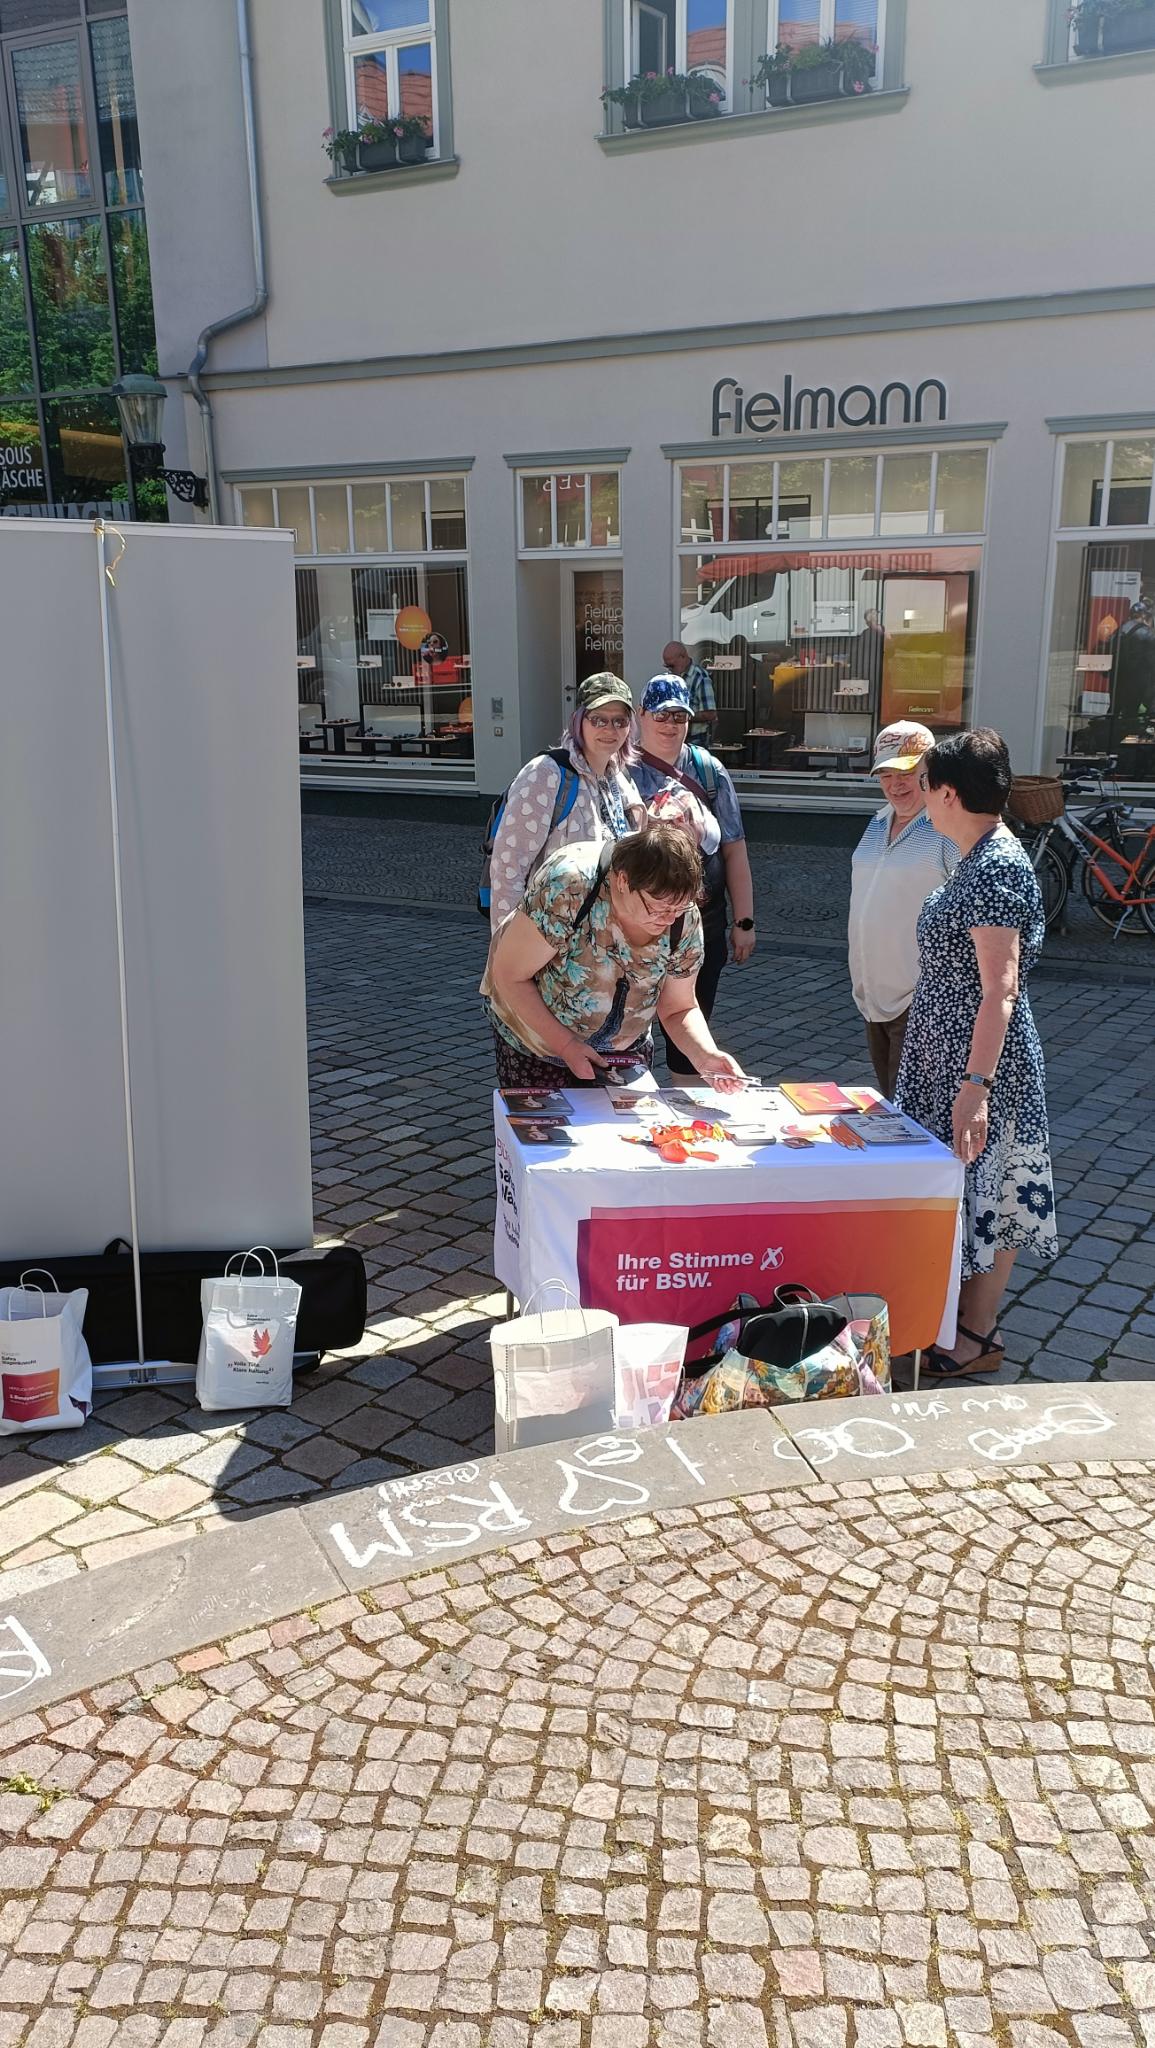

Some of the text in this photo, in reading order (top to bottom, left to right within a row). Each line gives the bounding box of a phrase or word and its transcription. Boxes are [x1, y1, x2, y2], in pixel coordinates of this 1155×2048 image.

[712, 374, 947, 436] fielmann
[616, 1252, 754, 1270] Ihre Stimme
[616, 1272, 712, 1291] für BSW.
